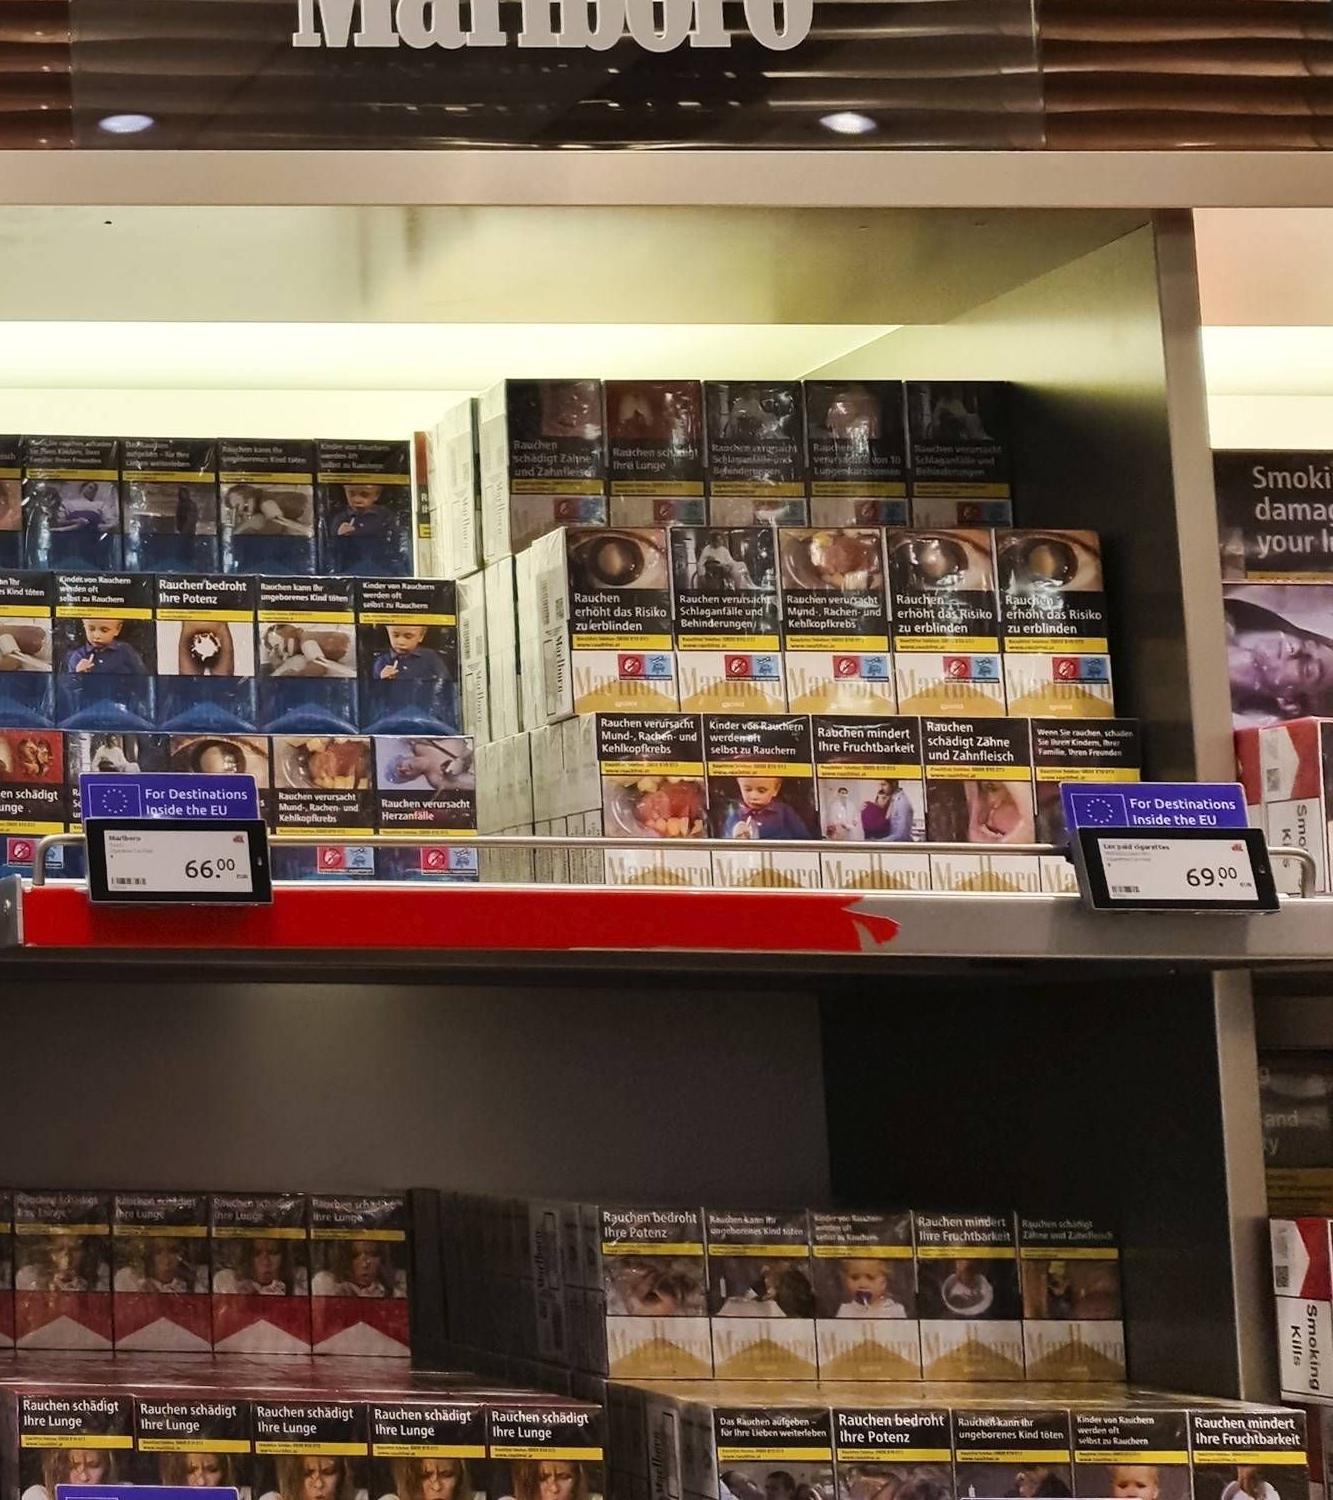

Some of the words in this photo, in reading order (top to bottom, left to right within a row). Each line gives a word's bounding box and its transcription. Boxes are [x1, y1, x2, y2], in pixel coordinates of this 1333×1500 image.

[1252, 465, 1333, 490] Smoki
[1257, 534, 1315, 559] your
[159, 579, 203, 590] Rauchen
[205, 580, 247, 591] bedroht
[159, 593, 181, 603] Ihre
[182, 593, 218, 604] Potenz
[574, 593, 620, 603] Rauchen
[575, 606, 611, 617] erhöht
[614, 607, 632, 617] das
[635, 607, 667, 618] Risiko
[576, 622, 588, 631] zu
[590, 621, 643, 631] erblinden
[818, 727, 863, 738] Rauchen
[867, 728, 910, 739] mindert
[927, 722, 973, 732] Rauchen
[818, 741, 840, 752] Ihre
[843, 742, 915, 754] Fruchtbarkeit
[928, 737, 975, 748] schädigt
[977, 737, 1010, 747] Zähne
[929, 751, 950, 760] und
[953, 751, 1014, 762] Zahnfleisch
[145, 789, 165, 799] For
[169, 789, 248, 800] Destinations
[146, 805, 185, 815] Inside
[187, 805, 208, 815] the
[211, 805, 227, 815] EU
[381, 799, 421, 808] Rauchen
[422, 799, 470, 809] verursacht
[1130, 799, 1151, 810] For
[1155, 799, 1236, 810] Destinations
[382, 811, 434, 820] Herzanfälle
[1133, 815, 1171, 826] Inside
[1174, 815, 1196, 826] the
[1200, 815, 1217, 826] EU
[185, 858, 235, 879] 66.00
[1187, 867, 1237, 887] 69.00
[1291, 1324, 1301, 1366] Kills
[1306, 1303, 1319, 1390] Smoking
[257, 1406, 304, 1418] Rauchen
[307, 1406, 354, 1419] schädigt
[1195, 1416, 1245, 1429] Rauchen
[1248, 1417, 1295, 1429] mindert
[258, 1422, 280, 1433] Ihre
[283, 1423, 317, 1436] Lunge
[1196, 1432, 1220, 1444] Ihre
[1223, 1433, 1301, 1445] Fruchtbarkeit
